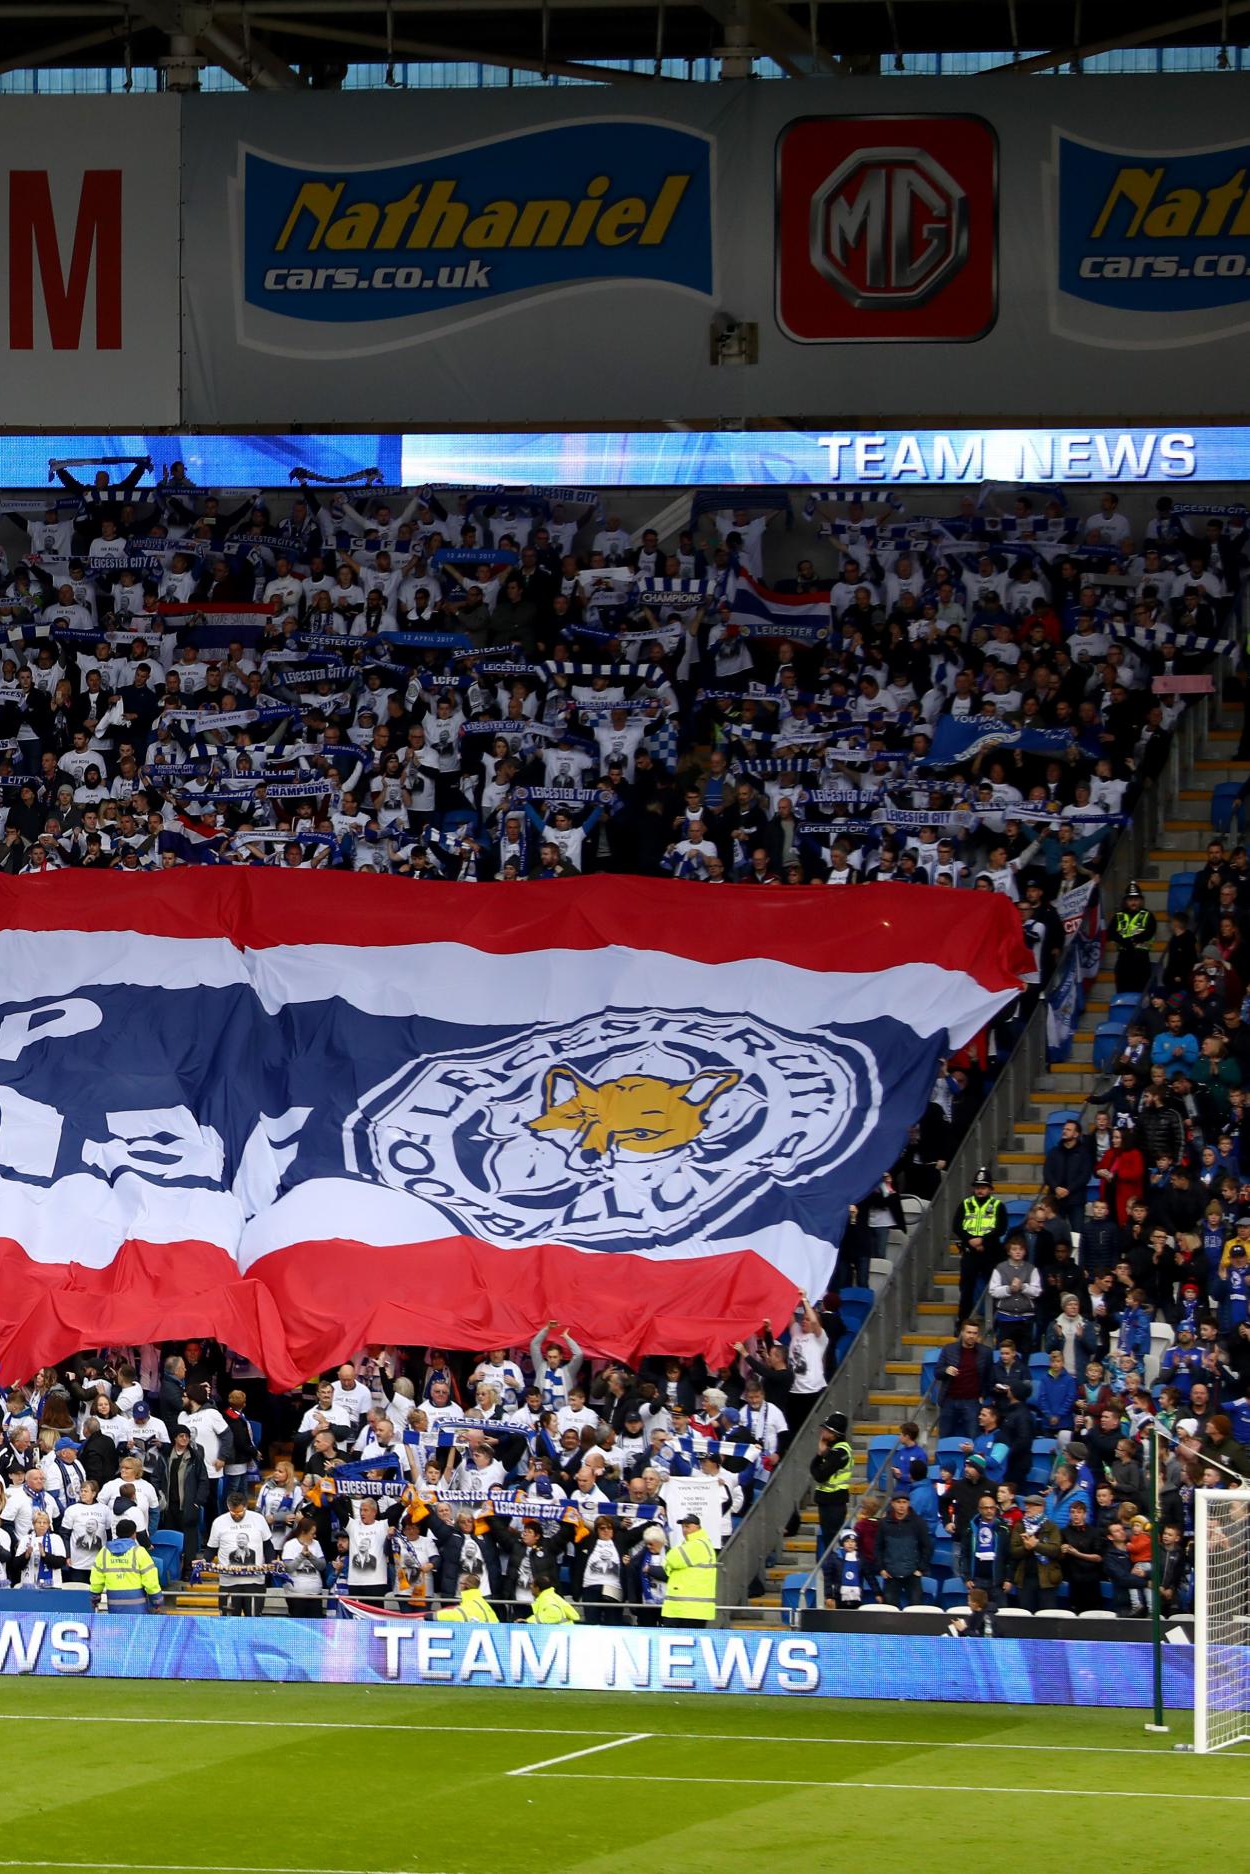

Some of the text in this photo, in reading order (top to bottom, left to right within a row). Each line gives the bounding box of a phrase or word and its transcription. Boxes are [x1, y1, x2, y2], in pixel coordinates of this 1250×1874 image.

[274, 174, 692, 253] Nathaniel
[830, 167, 948, 289] MG
[264, 260, 492, 292] cars.co.uk
[818, 433, 1198, 481] TEAM NEWS
[574, 491, 597, 503] CITY
[90, 557, 126, 569] LEICESTER
[128, 557, 147, 568] CITY
[642, 592, 703, 604] CHAMPIONS
[755, 626, 812, 637] LEICESTER
[300, 636, 368, 647] LEICESTER CITY
[414, 635, 434, 643] APRIL
[437, 636, 454, 645] 2017
[483, 664, 526, 672] LEICESTER
[284, 669, 347, 683] LEICESTER CITY
[432, 675, 459, 685] LCFC
[464, 722, 501, 733] LEICESTER
[267, 786, 329, 798] CHAMPIONS
[531, 786, 596, 801] LEICESTER CITY
[811, 788, 857, 803] LEICESTER
[886, 810, 951, 823] LEICESTER CITY
[799, 826, 870, 835] LEICESTER CITY
[438, 1417, 510, 1431] LEICESTER
[337, 1480, 407, 1497] LEICESTER CITY
[437, 1488, 515, 1501] LEICESTER CITY
[494, 1501, 564, 1521] LEICESTER CITY
[374, 1627, 819, 1691] TEAM NEWS
